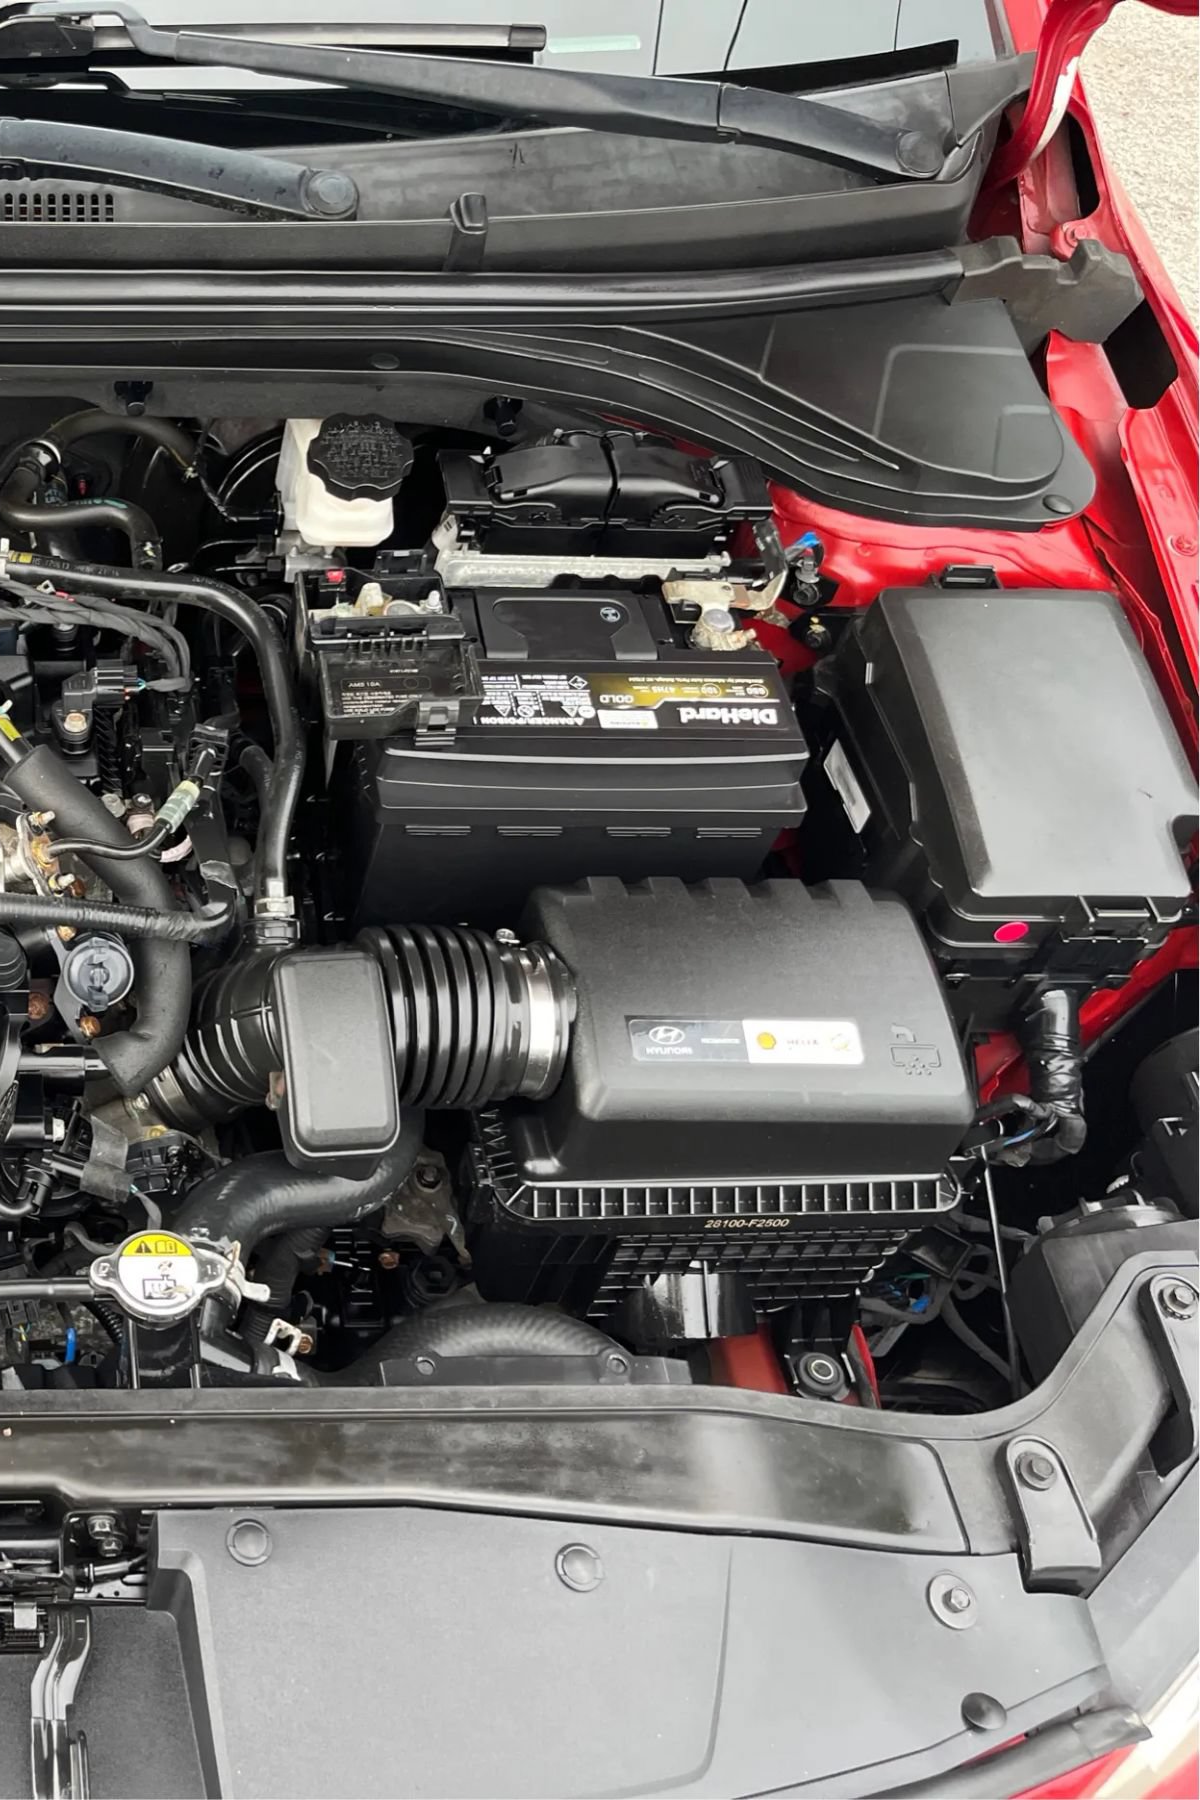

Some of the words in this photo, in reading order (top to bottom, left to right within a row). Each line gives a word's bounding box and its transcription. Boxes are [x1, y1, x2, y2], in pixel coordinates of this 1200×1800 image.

[599, 694, 635, 704] GOLD
[679, 706, 778, 725] DieHard
[480, 716, 576, 726] DANGER/POISON
[645, 1046, 693, 1056] HYUNDAI
[704, 1218, 790, 1229] 28100-F2500
